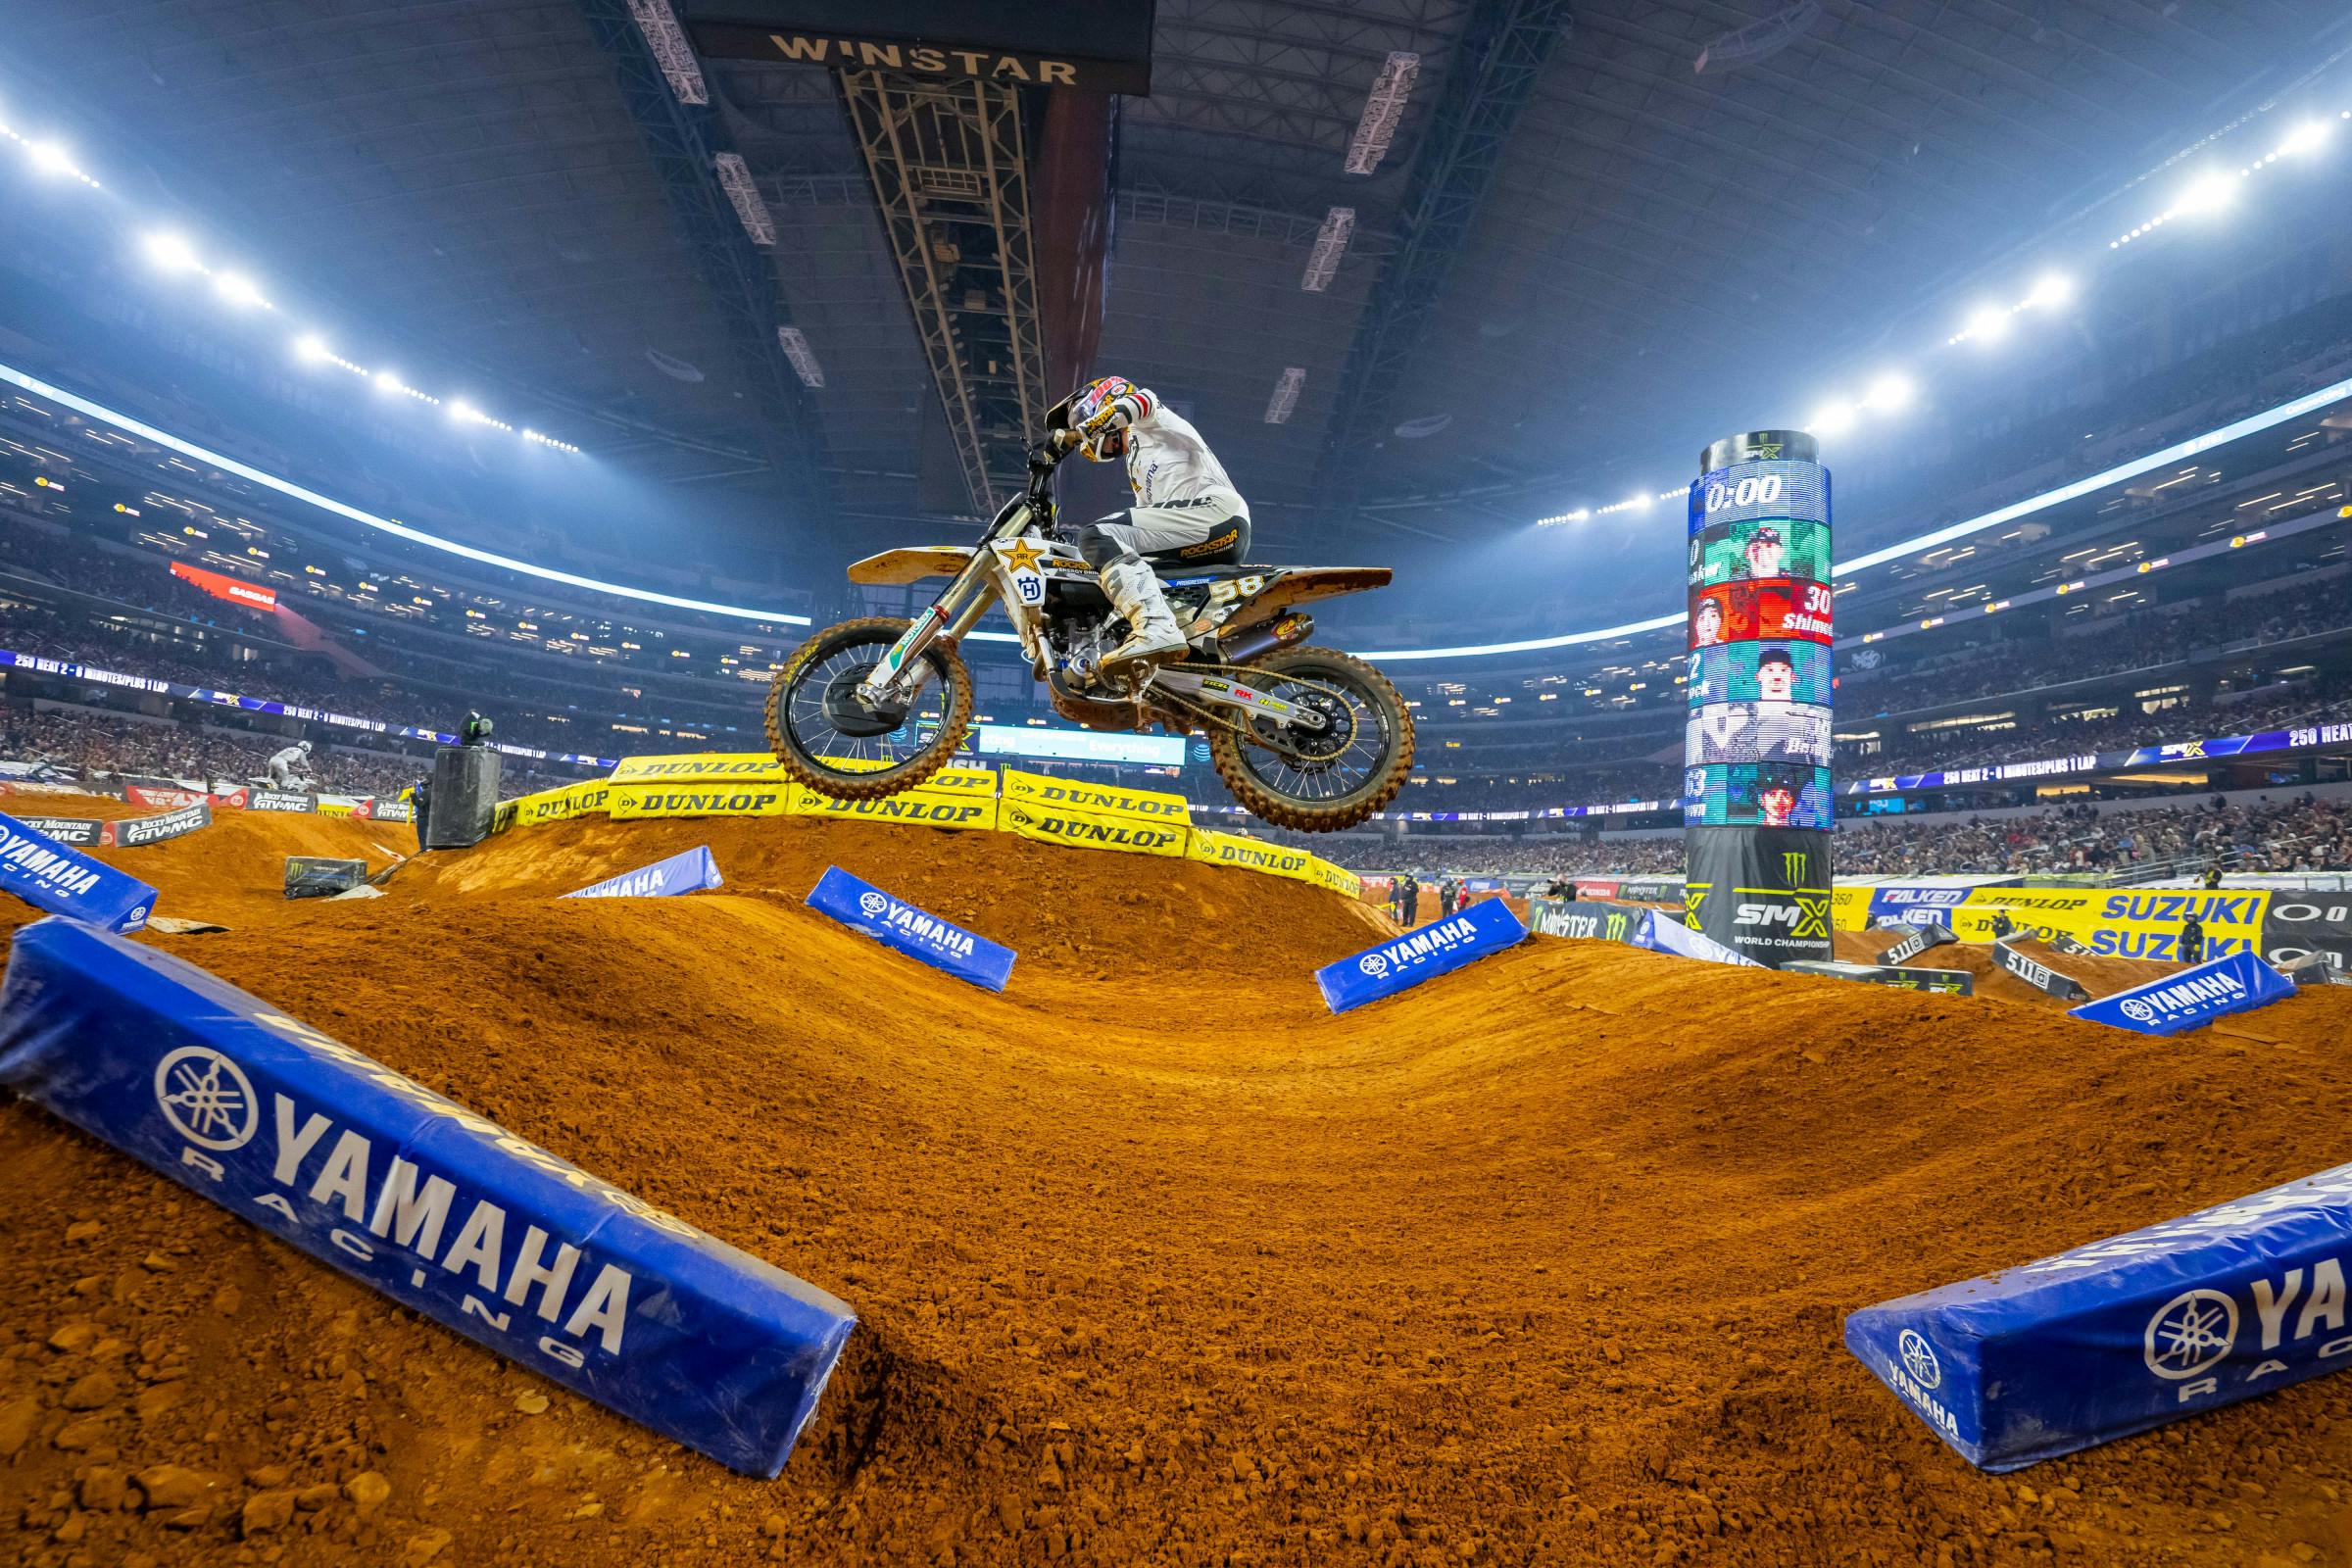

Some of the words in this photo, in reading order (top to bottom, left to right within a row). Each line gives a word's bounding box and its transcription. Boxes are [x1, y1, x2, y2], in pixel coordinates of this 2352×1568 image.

[769, 34, 1076, 85] WINSTAR
[1706, 474, 1783, 514] 0:00
[1180, 528, 1239, 558] ROCKSTAR
[1053, 559, 1092, 571] ROCKS
[228, 586, 275, 605] GASGAS
[1209, 575, 1265, 604] 58
[1804, 586, 1832, 614] 30
[901, 610, 933, 647] MOTOREX
[15, 654, 35, 668] 250
[36, 658, 60, 673] HEAT
[60, 663, 68, 675] 2
[153, 680, 170, 693] LAP
[1234, 689, 1253, 701] RK
[298, 708, 314, 719] HEAT
[314, 710, 319, 720] 2
[375, 721, 386, 732] LAP
[1089, 739, 1160, 758] Everything
[2161, 741, 2205, 758] SMX
[2289, 727, 2317, 747] 250
[643, 760, 781, 776] DUNLOP
[1961, 768, 1981, 783] HEAT
[1982, 767, 1988, 780] 2
[2077, 756, 2097, 770] LAP
[537, 790, 609, 817] DUNLOP
[641, 794, 776, 810] DUNLOP
[826, 797, 983, 822] DUNLOP
[1040, 786, 1185, 817] DUNLOP
[43, 819, 92, 830] MOUNTAIN
[141, 818, 166, 830] ROCKY
[165, 808, 202, 824] MOUNTAIN
[1037, 817, 1176, 849] DUNLOP
[0, 835, 101, 895] YAMAHA
[1219, 845, 1306, 872] DUNLOP
[2, 862, 71, 898] CING
[586, 868, 664, 897] MAHA
[1325, 870, 1359, 894] DUNLOP
[1627, 884, 1658, 896] MONSTER
[1881, 890, 1965, 904] FALKEN
[1989, 896, 2088, 910] DUNLOP
[2101, 895, 2261, 925] SUZUKI
[886, 901, 974, 956] YAMAHA
[1540, 907, 1598, 938] MONSTER
[1733, 897, 1830, 938] SMX
[1976, 918, 2074, 942] DNLOP
[861, 911, 964, 960] RACING
[1382, 916, 1478, 965] YAMAHA
[1734, 936, 1773, 947] WORLD
[1377, 936, 1476, 980] RACING
[1886, 943, 1912, 965] 5.11
[2005, 952, 2034, 982] 5.11
[2141, 971, 2244, 1013] YAMAHA
[2146, 991, 2246, 1027] RACING
[272, 1092, 632, 1355] YAMAHA
[181, 1147, 588, 1371] RACING
[2179, 1336, 2352, 1403] RAC
[1888, 1359, 1959, 1443] YAMAHA
